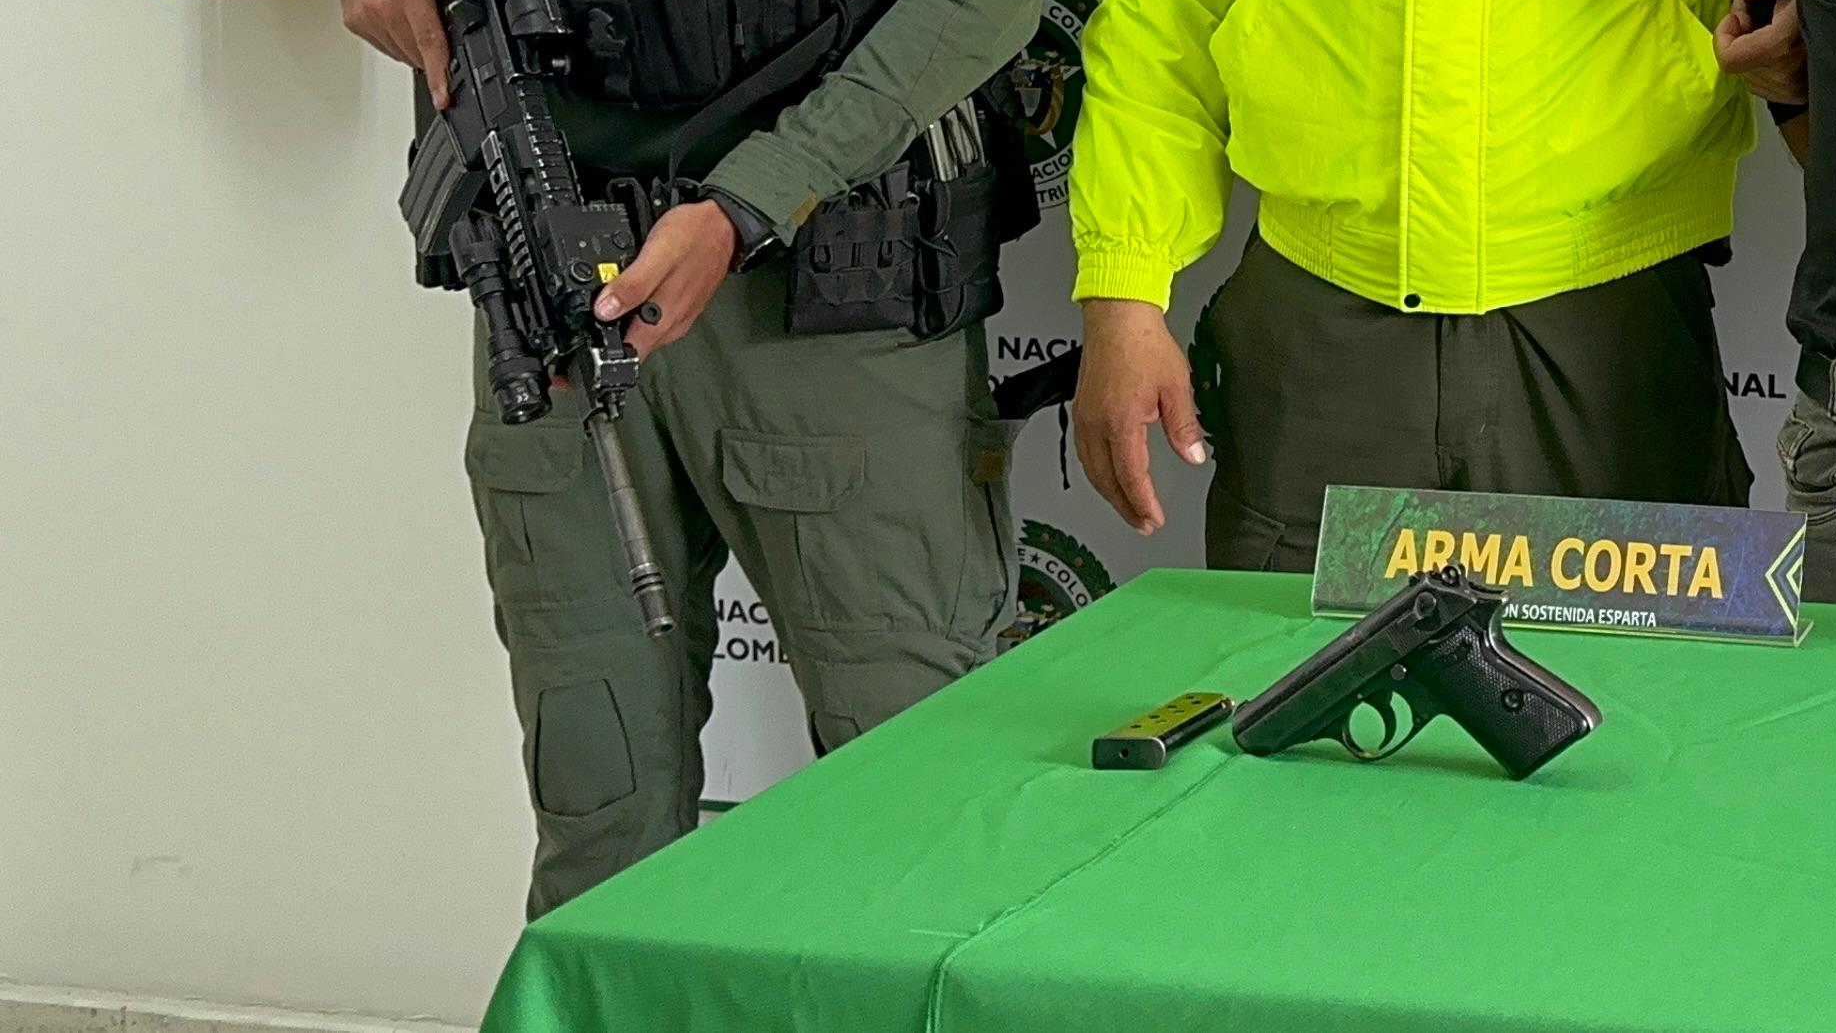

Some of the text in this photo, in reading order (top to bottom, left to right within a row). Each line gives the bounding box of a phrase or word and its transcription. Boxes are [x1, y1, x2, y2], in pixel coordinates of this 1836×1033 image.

[1045, 560, 1088, 607] COLO
[1385, 528, 1724, 599] ARMA CORTA
[1522, 605, 1595, 624] SOSTENIDA
[1599, 609, 1657, 627] ESPARTA
